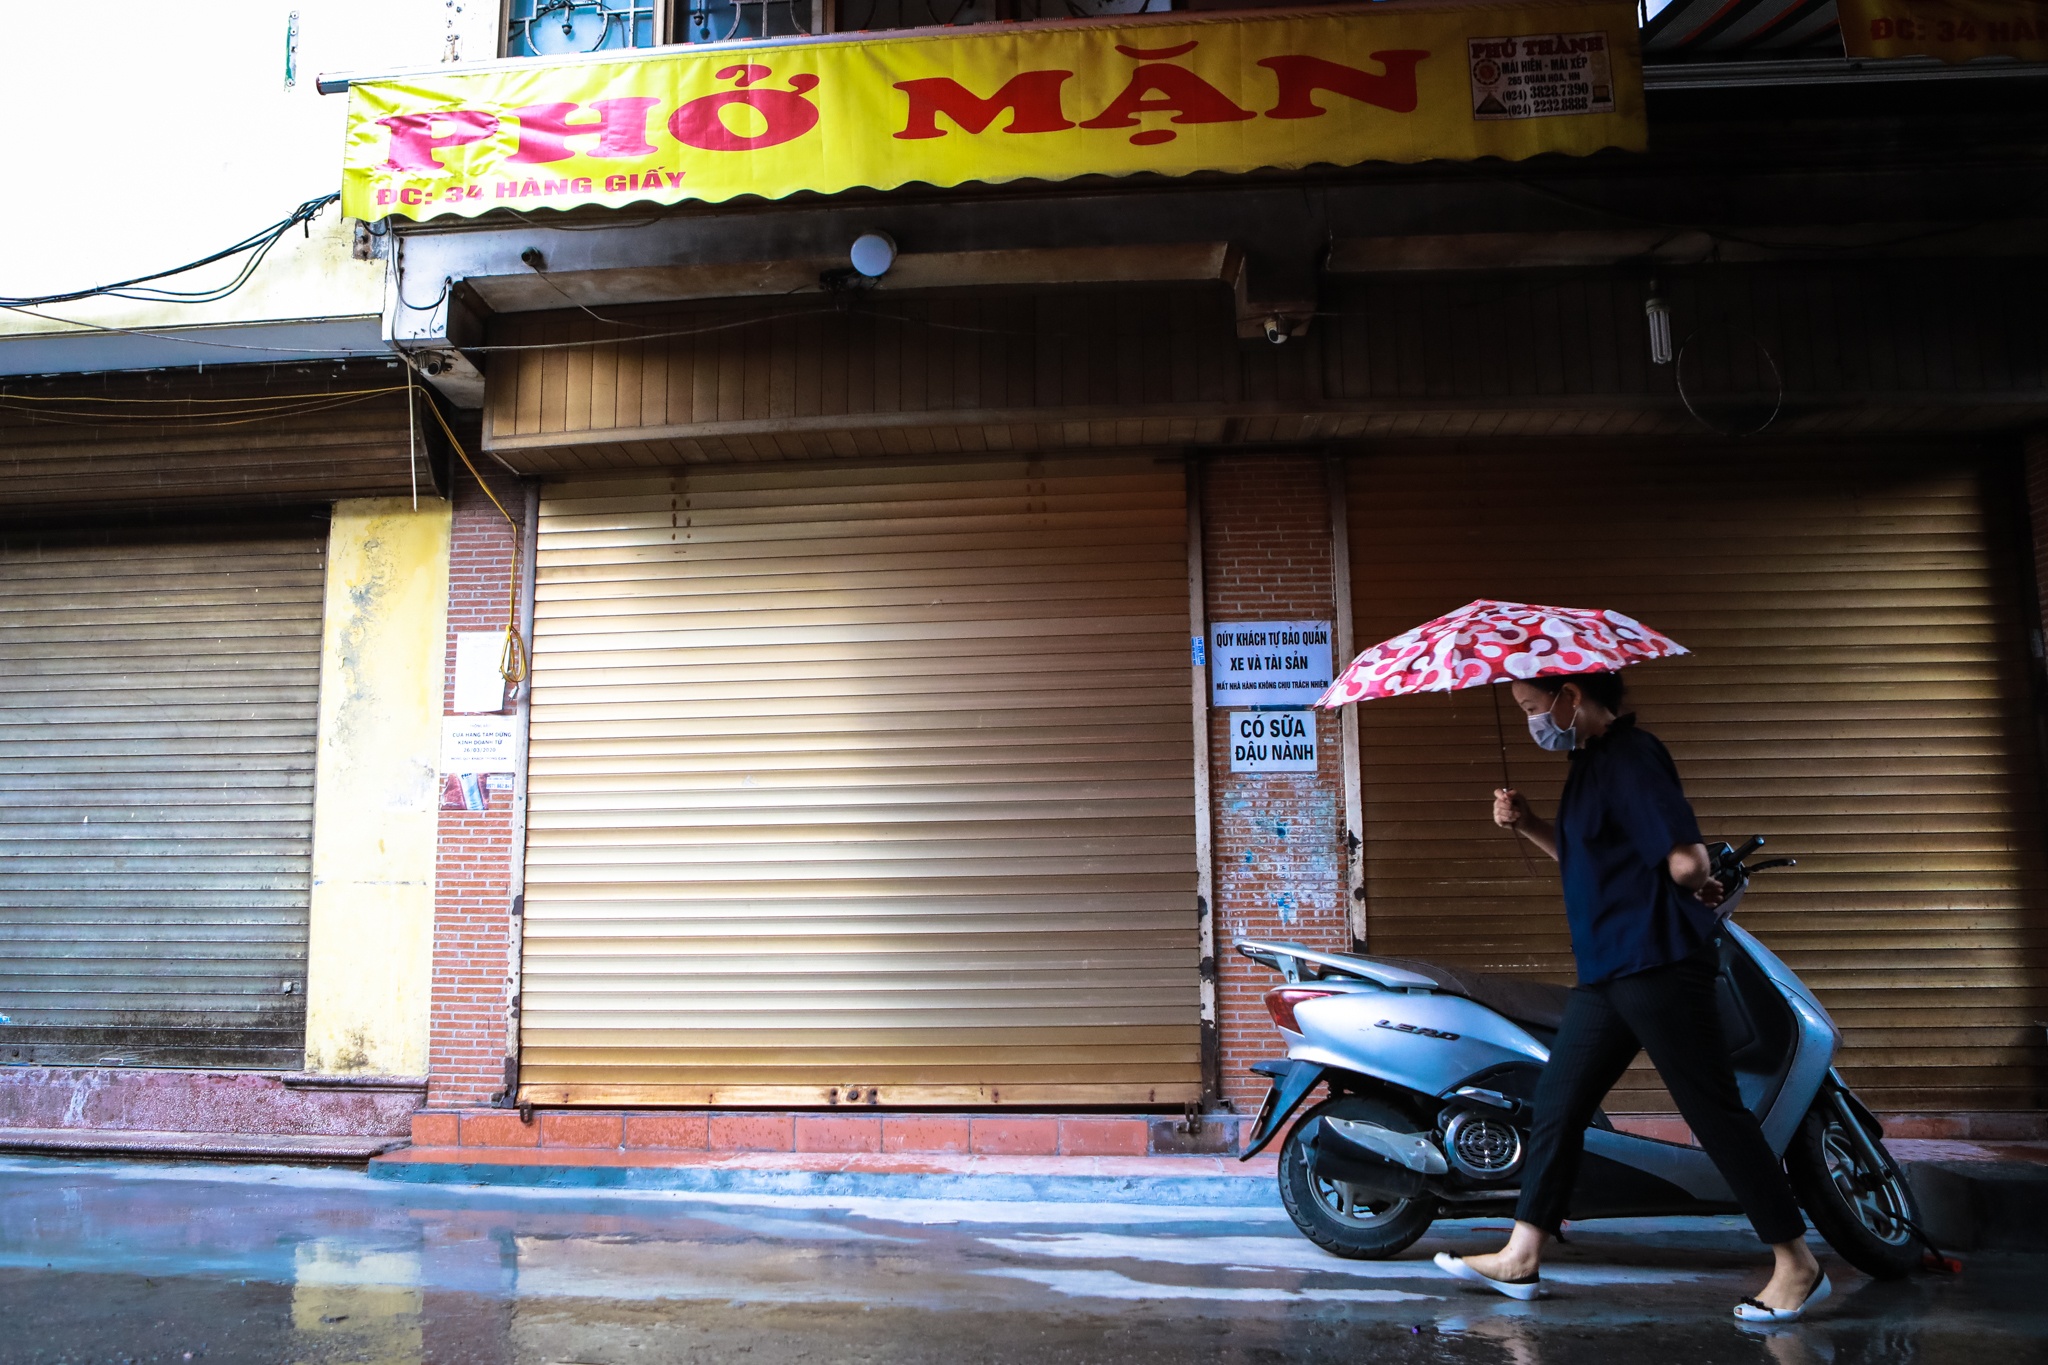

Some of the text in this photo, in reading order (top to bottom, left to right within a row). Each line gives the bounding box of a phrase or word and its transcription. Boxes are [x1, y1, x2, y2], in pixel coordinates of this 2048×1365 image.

[1870, 17, 1926, 41] ĐC:
[1937, 20, 1977, 42] 34
[1471, 34, 1604, 59] PHÚ THÀNH
[1501, 59, 1519, 74] MÁI
[1550, 56, 1569, 71] MÁI
[1524, 73, 1546, 84] QUAN
[1502, 82, 1589, 103] (024) 3828.7390
[375, 40, 1432, 173] PHỞ MẶN
[1508, 103, 1531, 117] (024)
[377, 166, 686, 206] ĐC: 34 HÀNG GIẤY
[1216, 626, 1327, 648] QÚY KHÁCH TỰ BẢO QUẢN
[1230, 650, 1308, 671] XE VÀ TÀI SẢN
[1240, 714, 1306, 738] CÓ SỮA
[1235, 740, 1314, 766] ĐẬU NÀNH
[1373, 1019, 1461, 1041] LEAD
